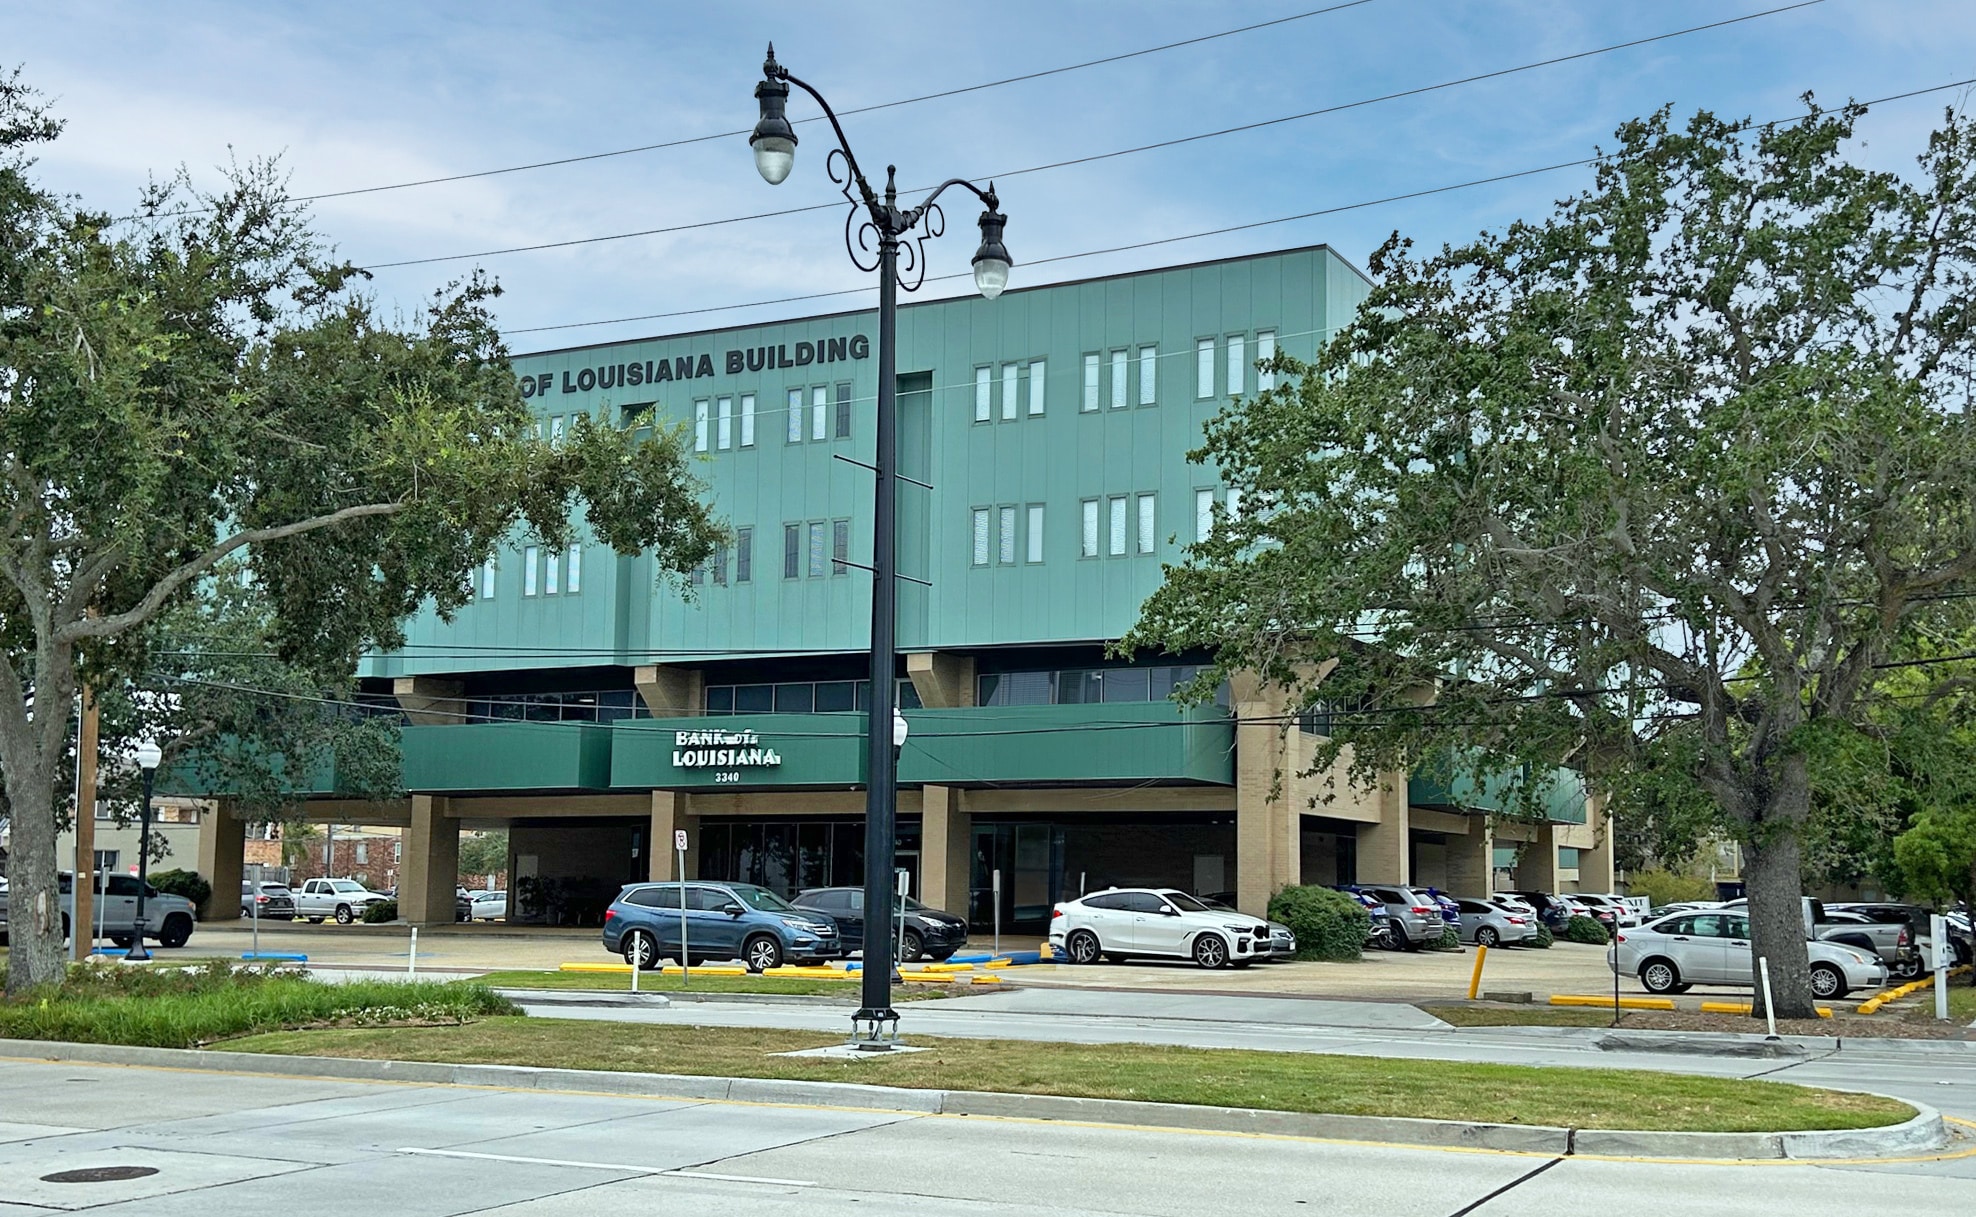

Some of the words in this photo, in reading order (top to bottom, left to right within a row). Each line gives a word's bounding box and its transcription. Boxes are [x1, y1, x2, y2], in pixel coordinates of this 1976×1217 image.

[520, 375, 553, 398] OF
[562, 353, 714, 394] LOUISIANA
[726, 334, 870, 374] BUILDING
[675, 730, 725, 746] BANK
[672, 749, 780, 766] LOUISIANA
[715, 772, 740, 782] 3340
